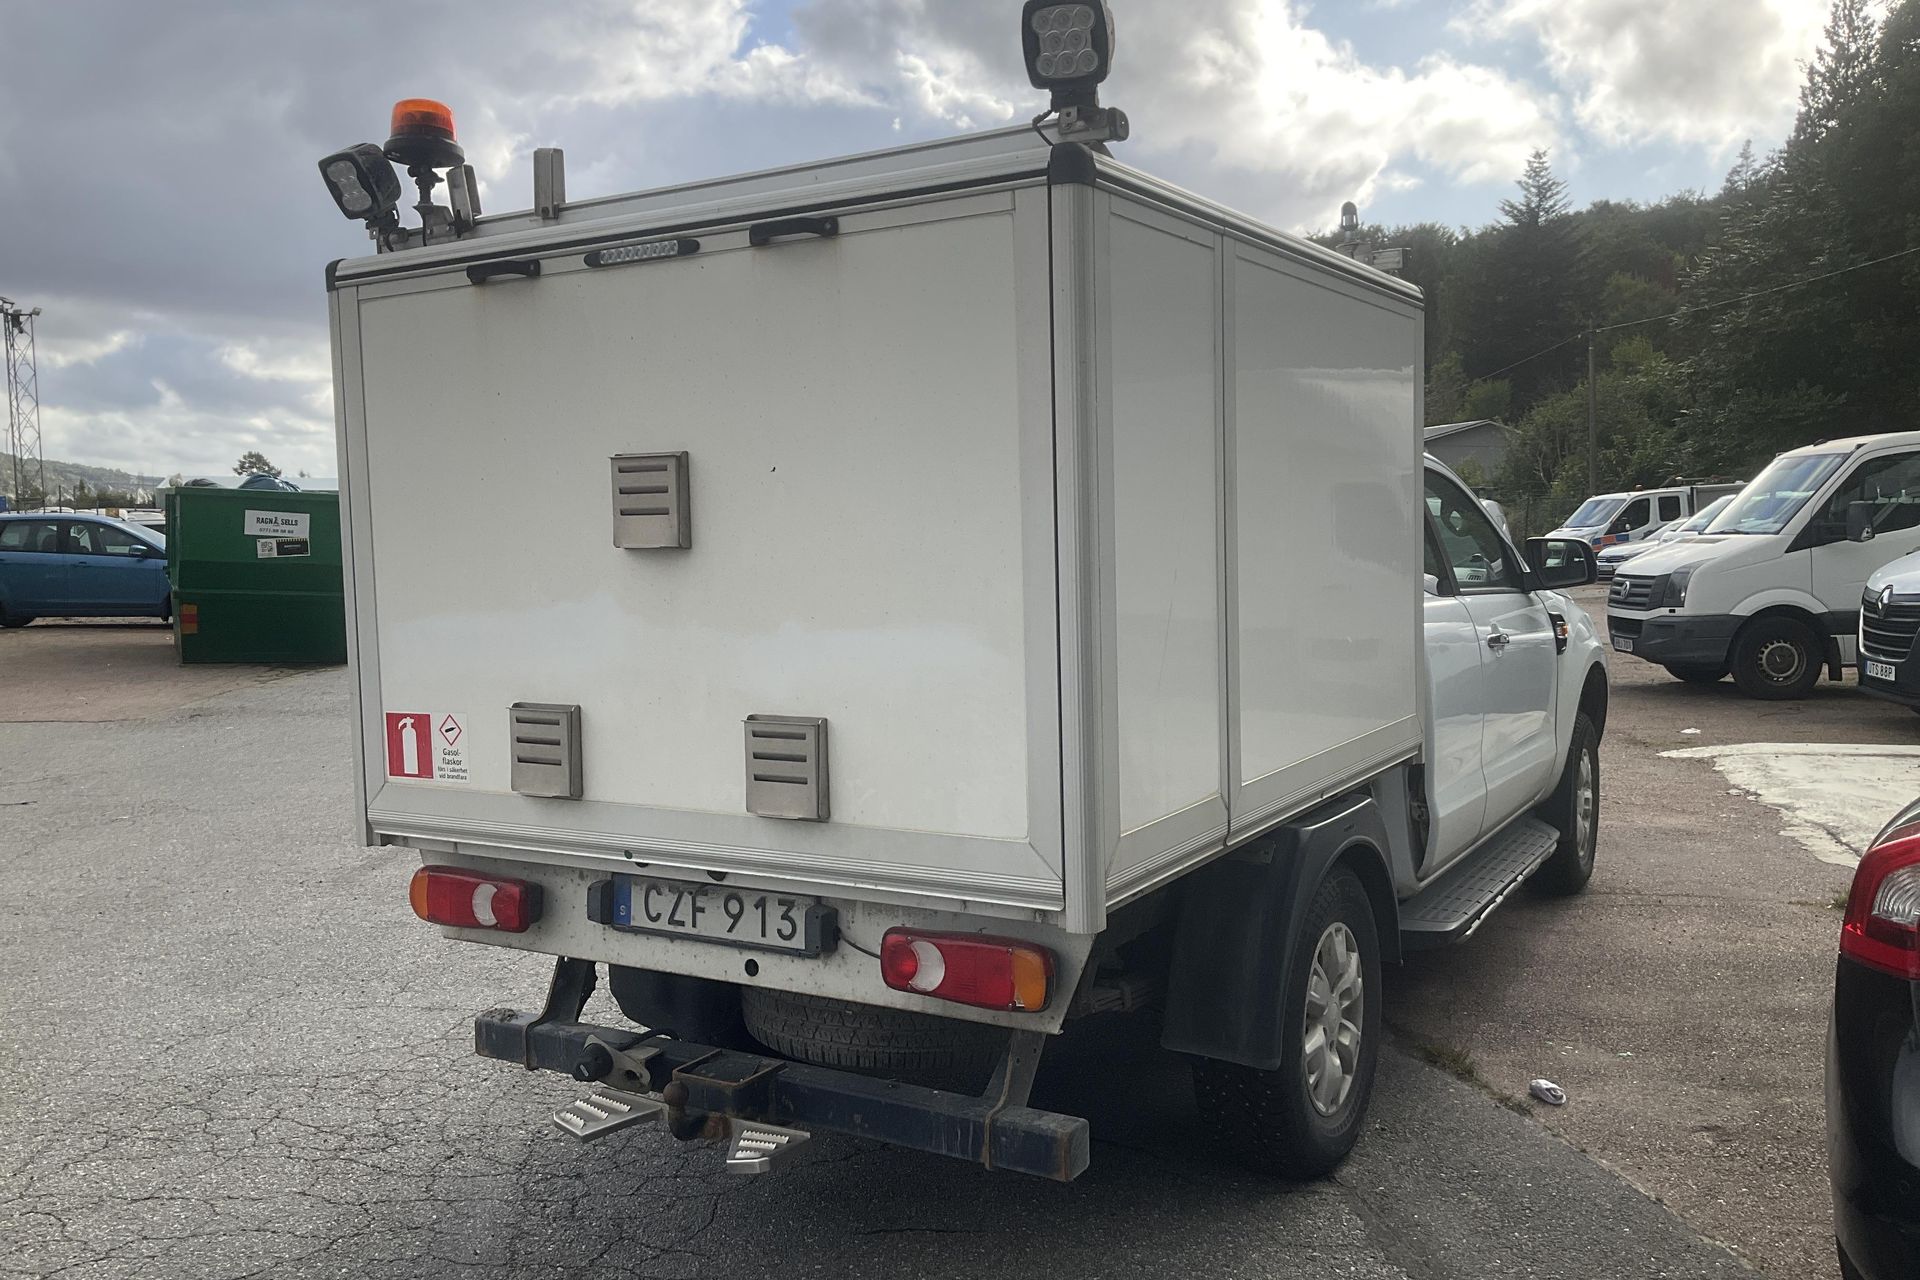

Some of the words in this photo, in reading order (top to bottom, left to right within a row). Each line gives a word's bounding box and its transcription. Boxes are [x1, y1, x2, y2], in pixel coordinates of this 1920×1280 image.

[281, 518, 298, 526] SELLS
[442, 748, 461, 756] Gasol-
[442, 757, 462, 766] flaskor
[619, 904, 626, 916] S
[644, 884, 708, 928] CZF
[723, 893, 797, 941] 913
